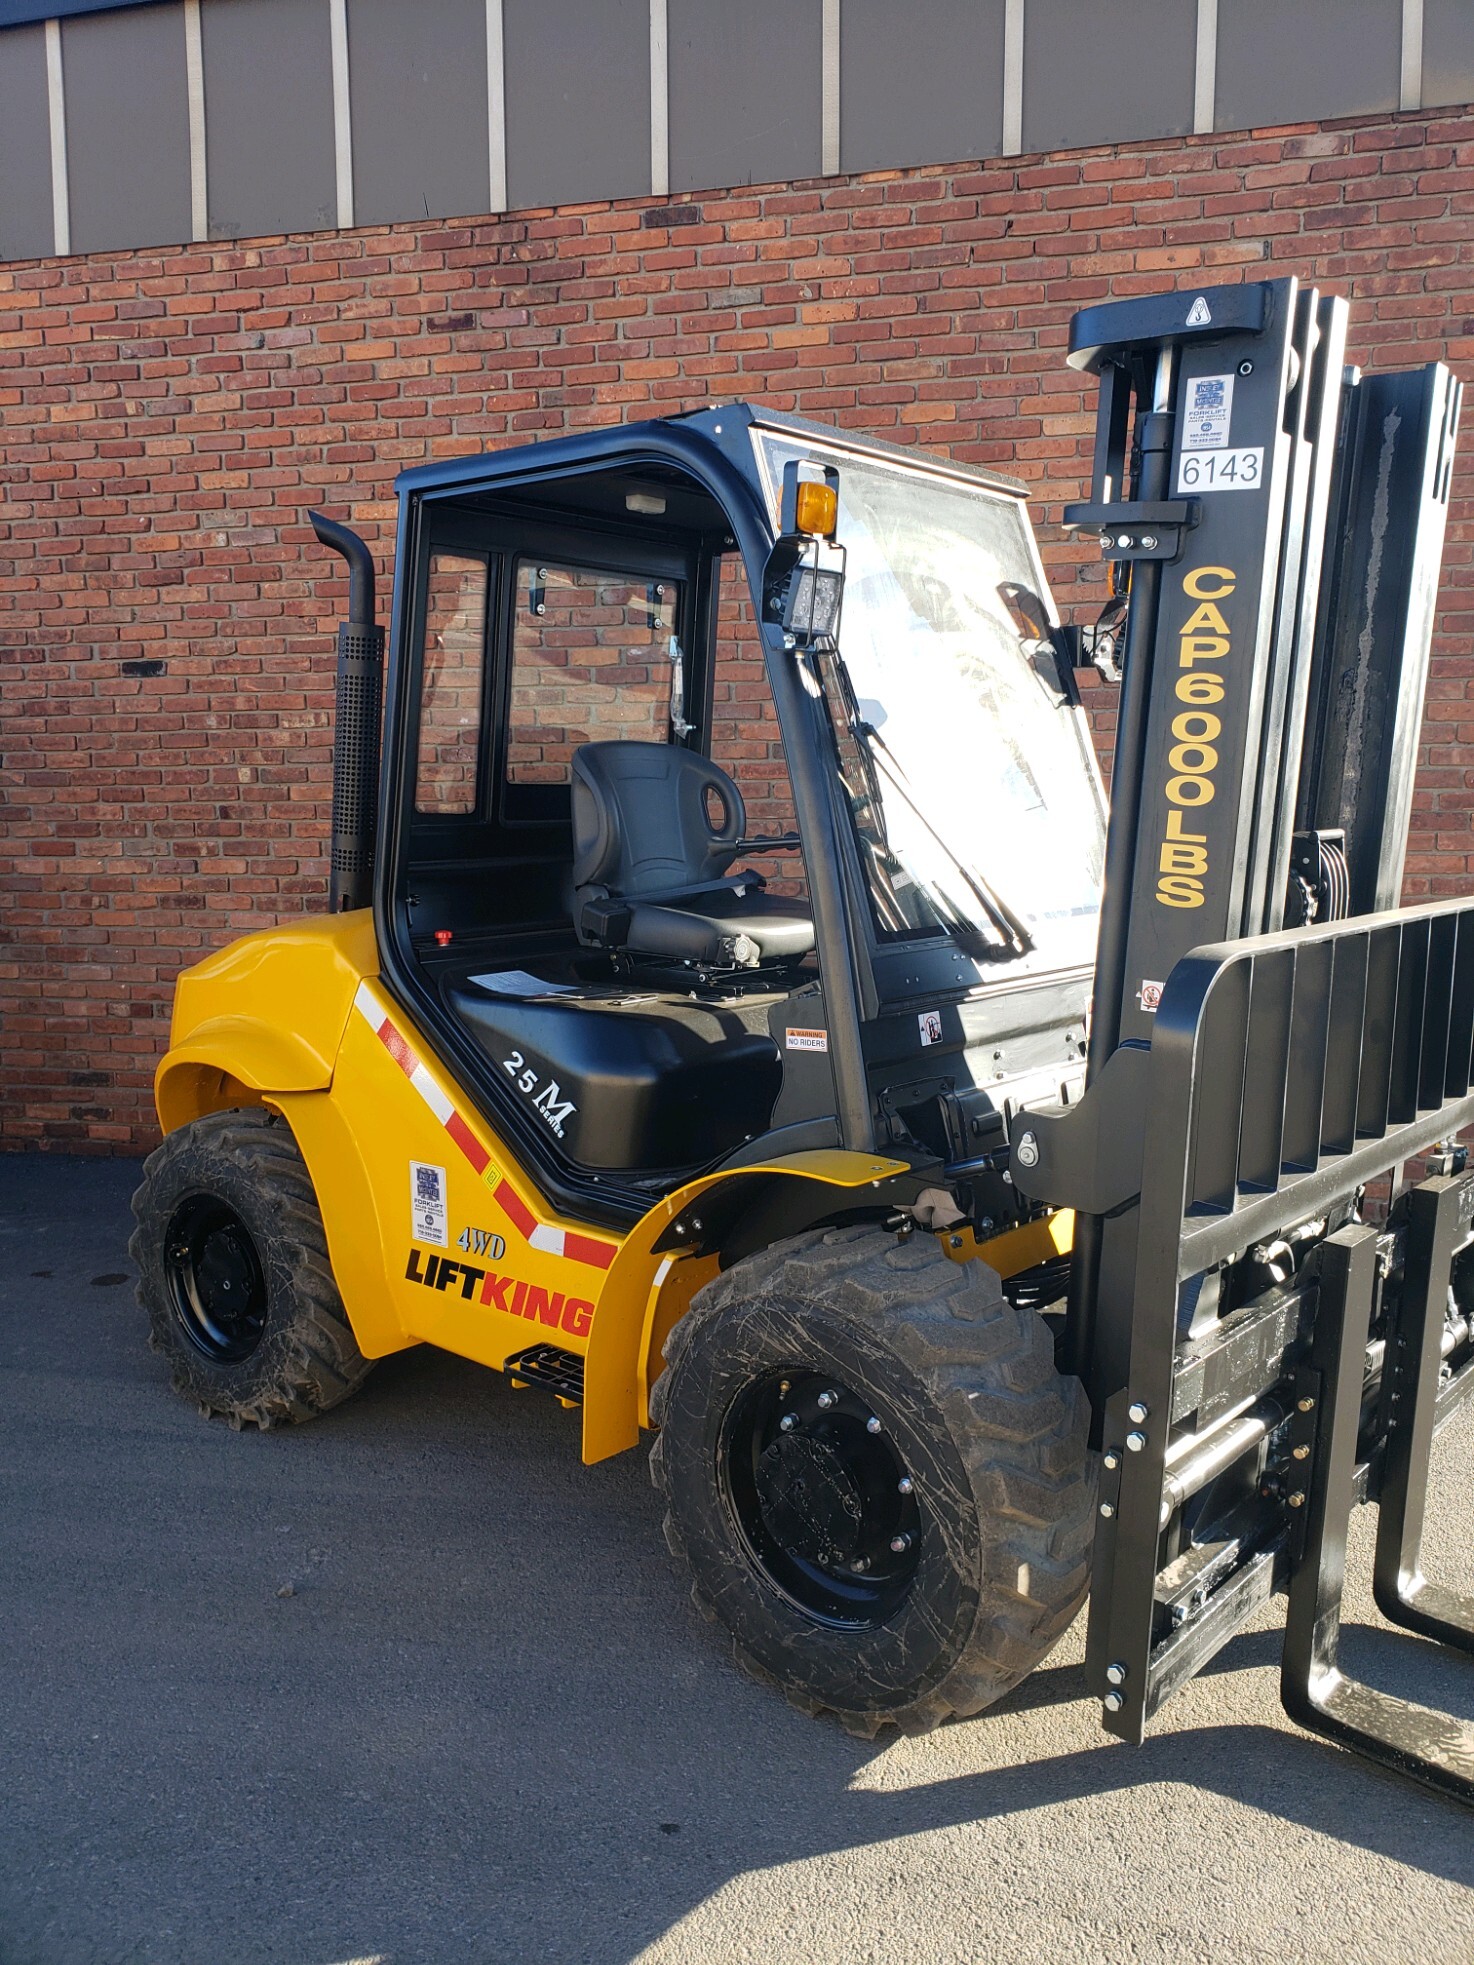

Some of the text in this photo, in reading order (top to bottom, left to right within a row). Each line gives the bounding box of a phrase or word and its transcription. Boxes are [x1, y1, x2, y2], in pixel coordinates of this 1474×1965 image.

[1188, 408, 1227, 417] FORKLIFT
[1183, 453, 1259, 485] 6143
[788, 1038, 826, 1048] NO RIDERS
[796, 1030, 823, 1039] WARNING
[539, 1104, 565, 1139] SERIES
[414, 1198, 444, 1210] FORKLIFT
[456, 1226, 506, 1261] 4WD
[405, 1248, 595, 1338] LIFTKING
